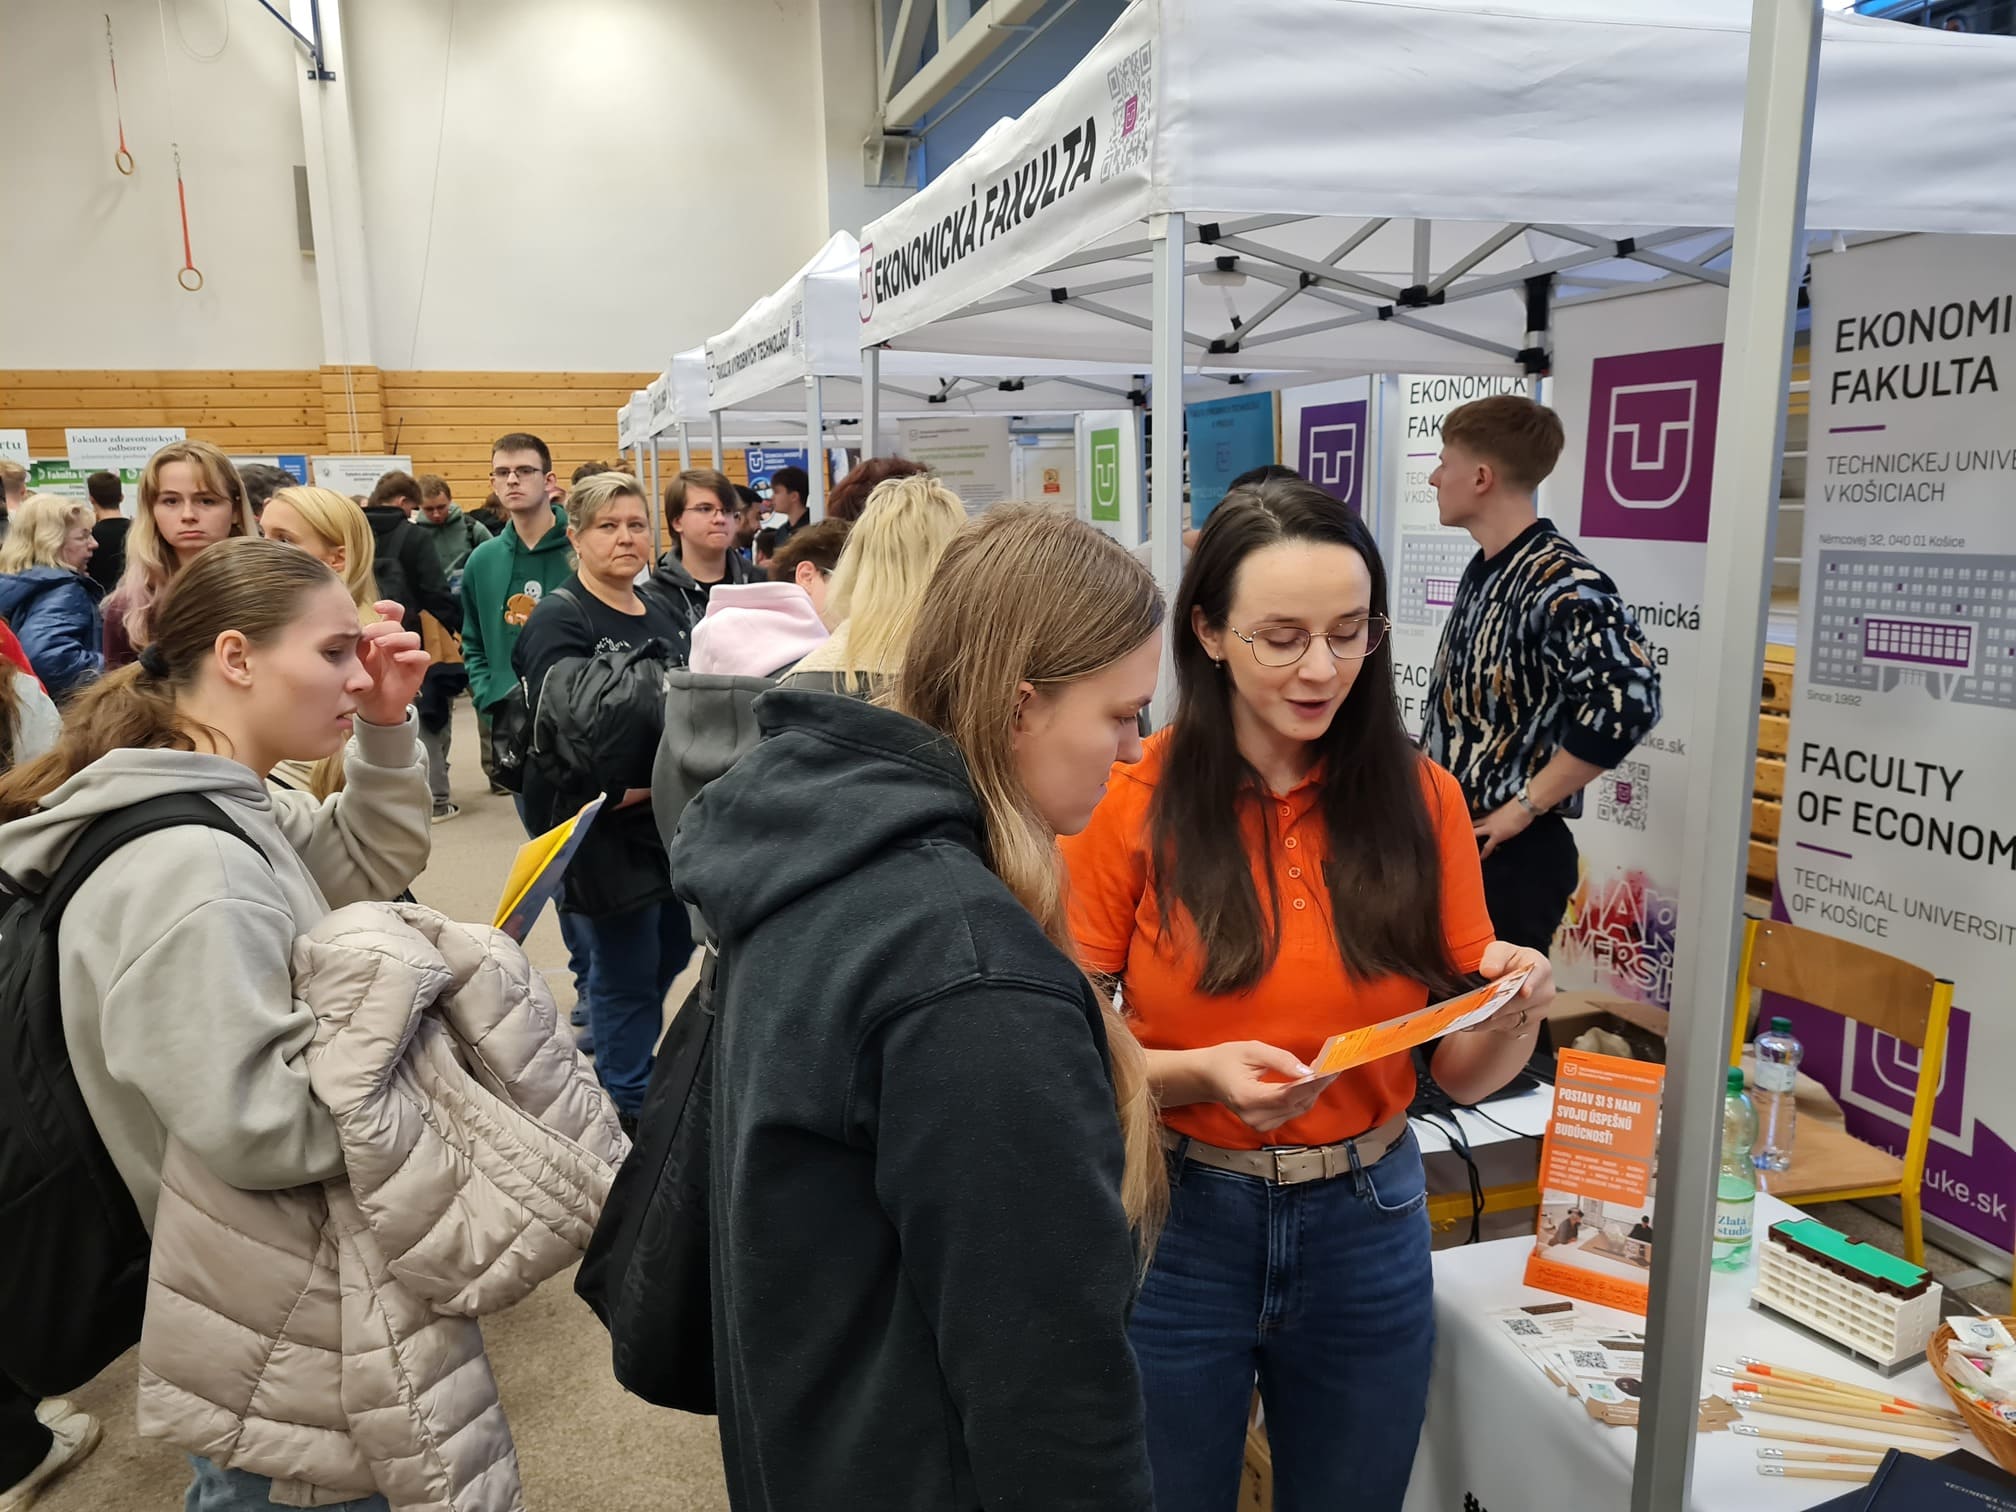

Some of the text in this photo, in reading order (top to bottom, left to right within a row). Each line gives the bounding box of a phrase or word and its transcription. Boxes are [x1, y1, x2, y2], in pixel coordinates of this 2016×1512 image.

[875, 116, 1097, 304] EKONOMICKÁ FAKULTA
[1835, 295, 2015, 353] EKONOMI
[1831, 355, 1999, 405] FAKULTA
[1408, 414, 1445, 439] FAK
[1826, 451, 1950, 475] TECHNICKEJ
[1405, 471, 1430, 486] TECH
[1824, 479, 1945, 503] V KOŠICIACH
[1411, 489, 1436, 504] KOŠI
[1393, 662, 1429, 688] FAC
[1801, 742, 1964, 802] FACULTY
[1798, 790, 2016, 871] OF ECONOM
[1791, 894, 1889, 939] OF KOŠICE
[1794, 867, 2016, 947] TECHNICAL UNIVERSIT
[1559, 1087, 1594, 1106] POSTAV
[1595, 1094, 1605, 1108] SI
[1606, 1097, 1614, 1109] S
[1556, 1105, 1588, 1122] SVOJU
